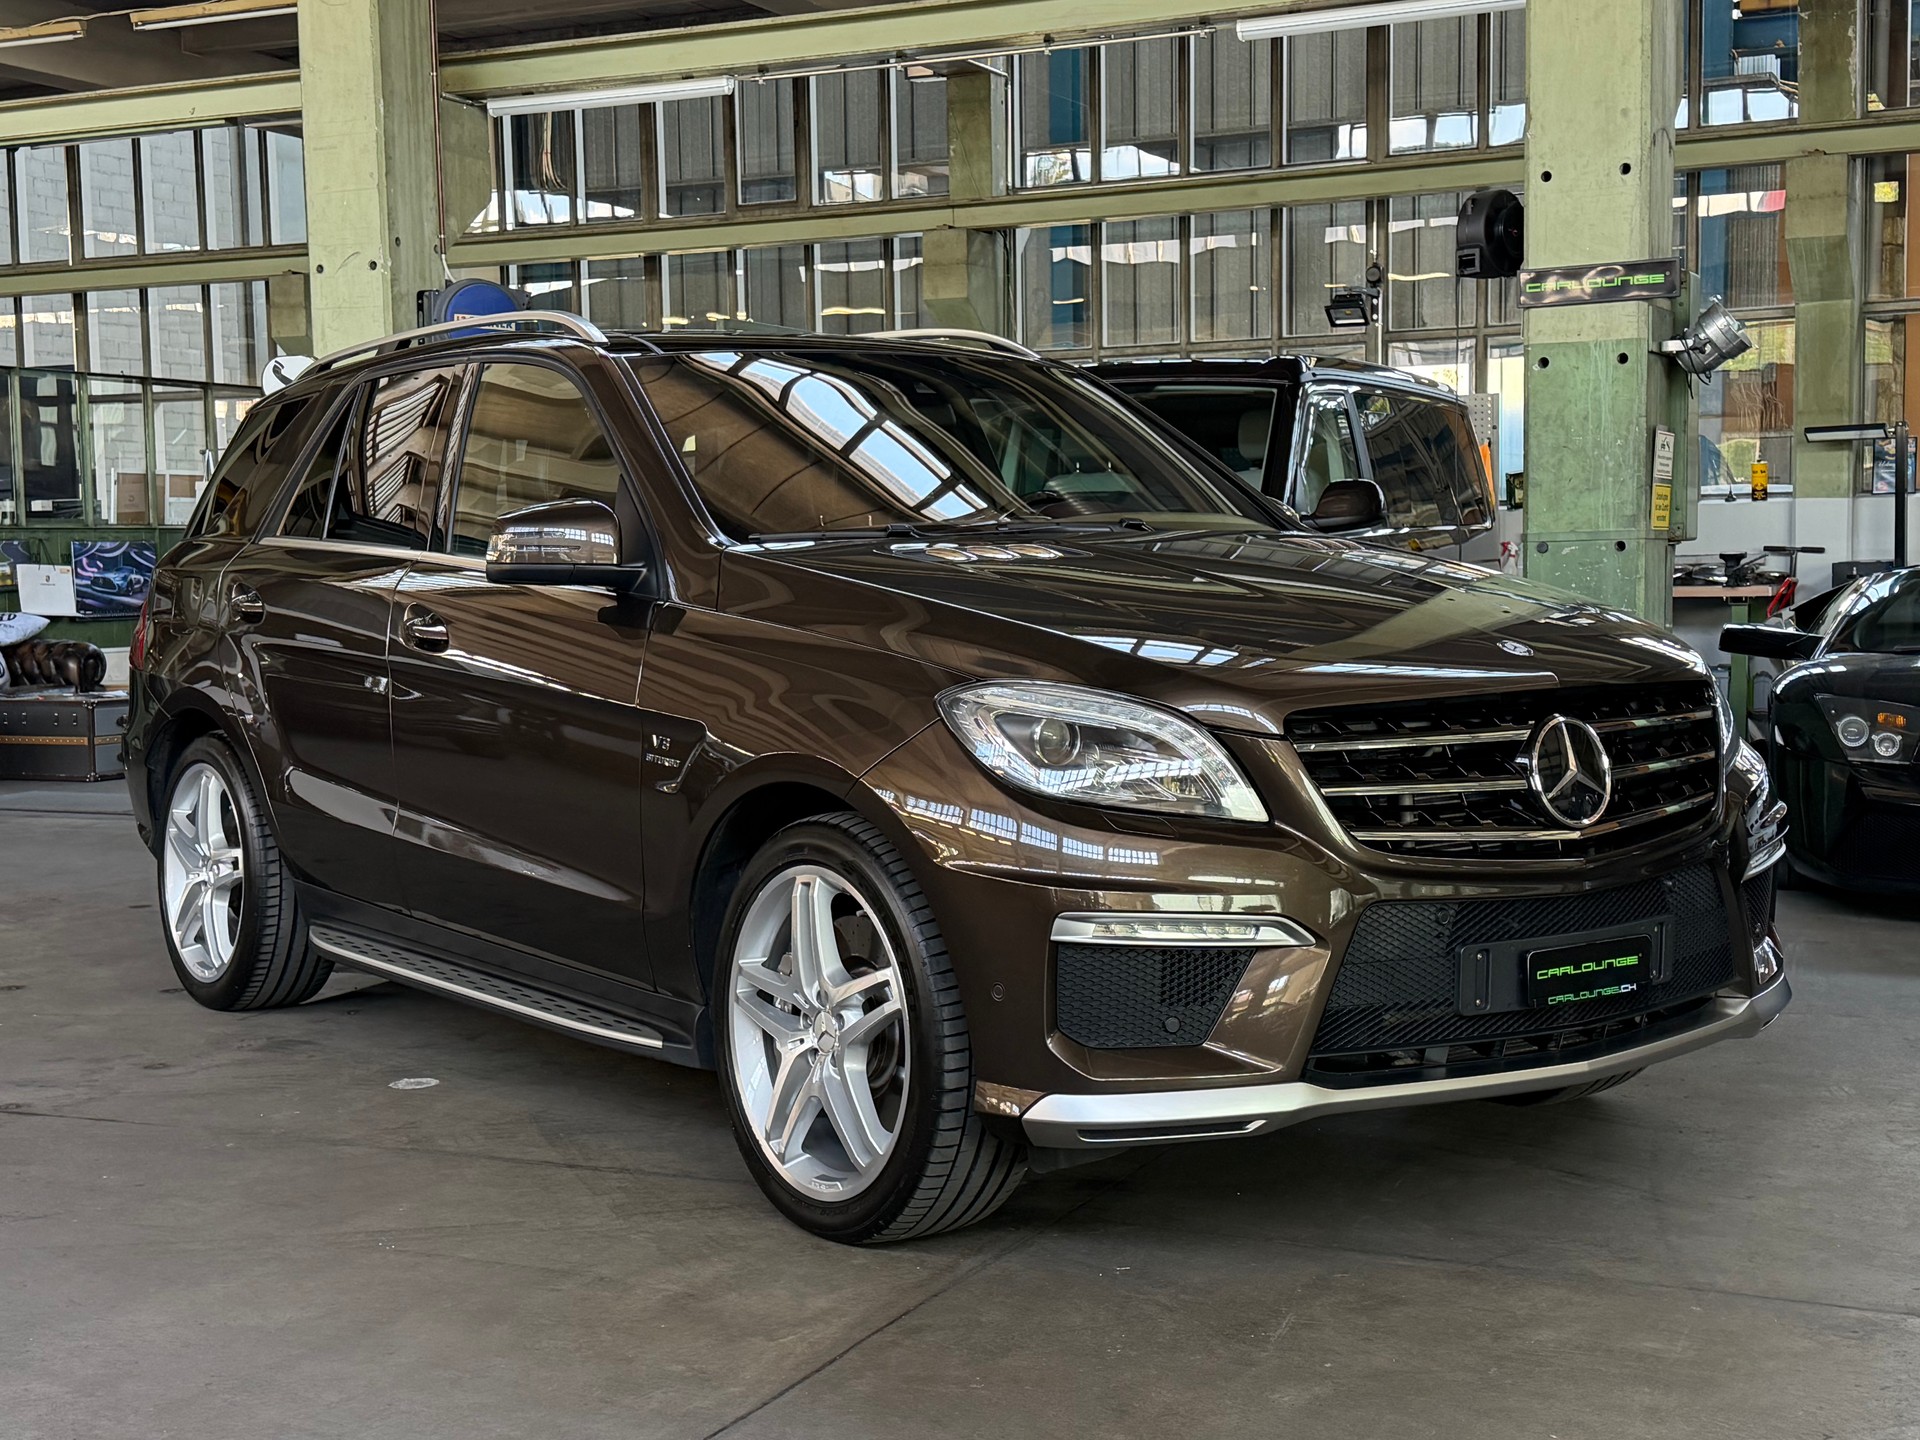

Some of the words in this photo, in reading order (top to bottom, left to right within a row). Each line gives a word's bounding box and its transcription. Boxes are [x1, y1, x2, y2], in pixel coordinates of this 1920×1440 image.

[1525, 273, 1666, 293] CARLOUNGE
[651, 734, 671, 751] V8
[1536, 955, 1639, 980] CARLOUNGE
[1547, 982, 1637, 1005] CARLOUNGE.CH
